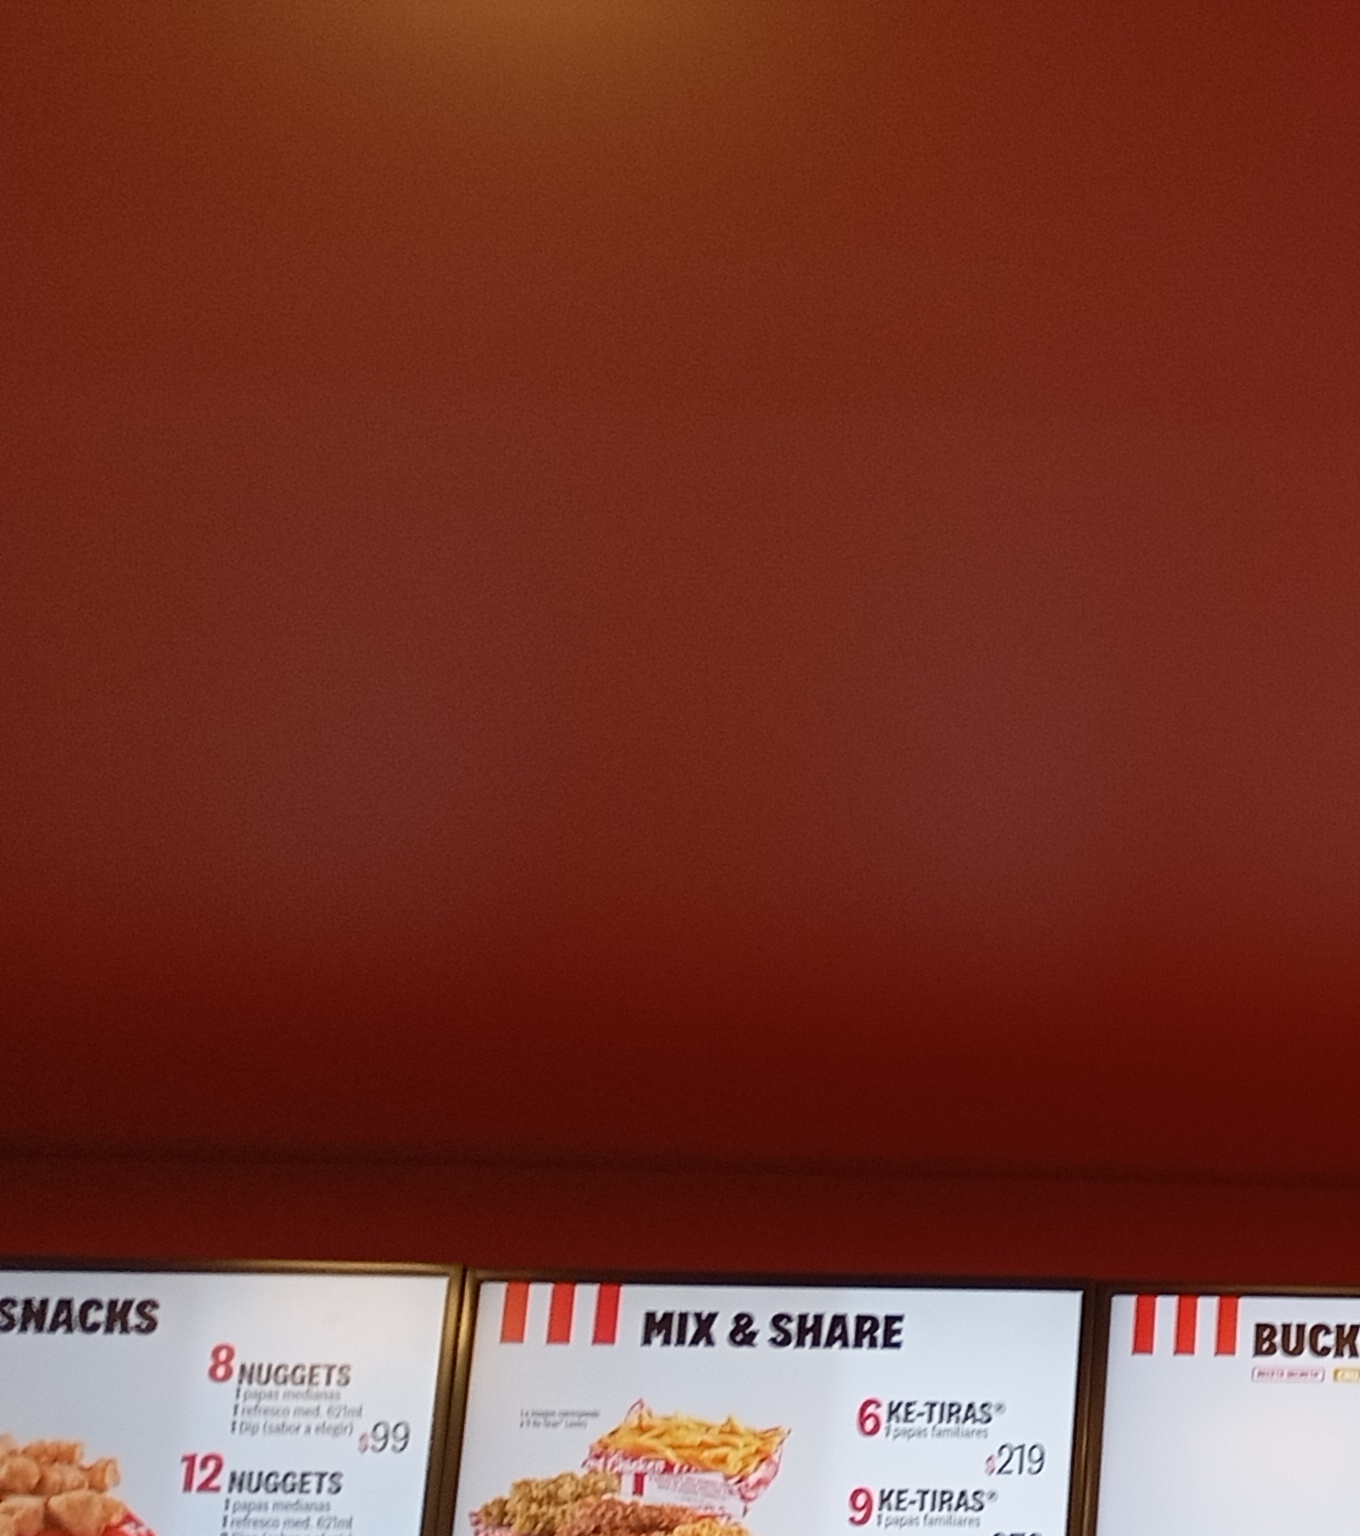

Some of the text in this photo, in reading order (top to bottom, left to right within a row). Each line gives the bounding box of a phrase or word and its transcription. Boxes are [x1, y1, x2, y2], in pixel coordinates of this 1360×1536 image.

[640, 1311, 905, 1350] MIX & SHARE
[207, 1343, 352, 1387] 8 NUGGETS
[857, 1398, 882, 1437] 6
[358, 1421, 411, 1455] $99
[181, 1453, 344, 1495] 12 NUGGETS
[985, 1444, 1046, 1476] $219
[848, 1488, 873, 1526] 9
